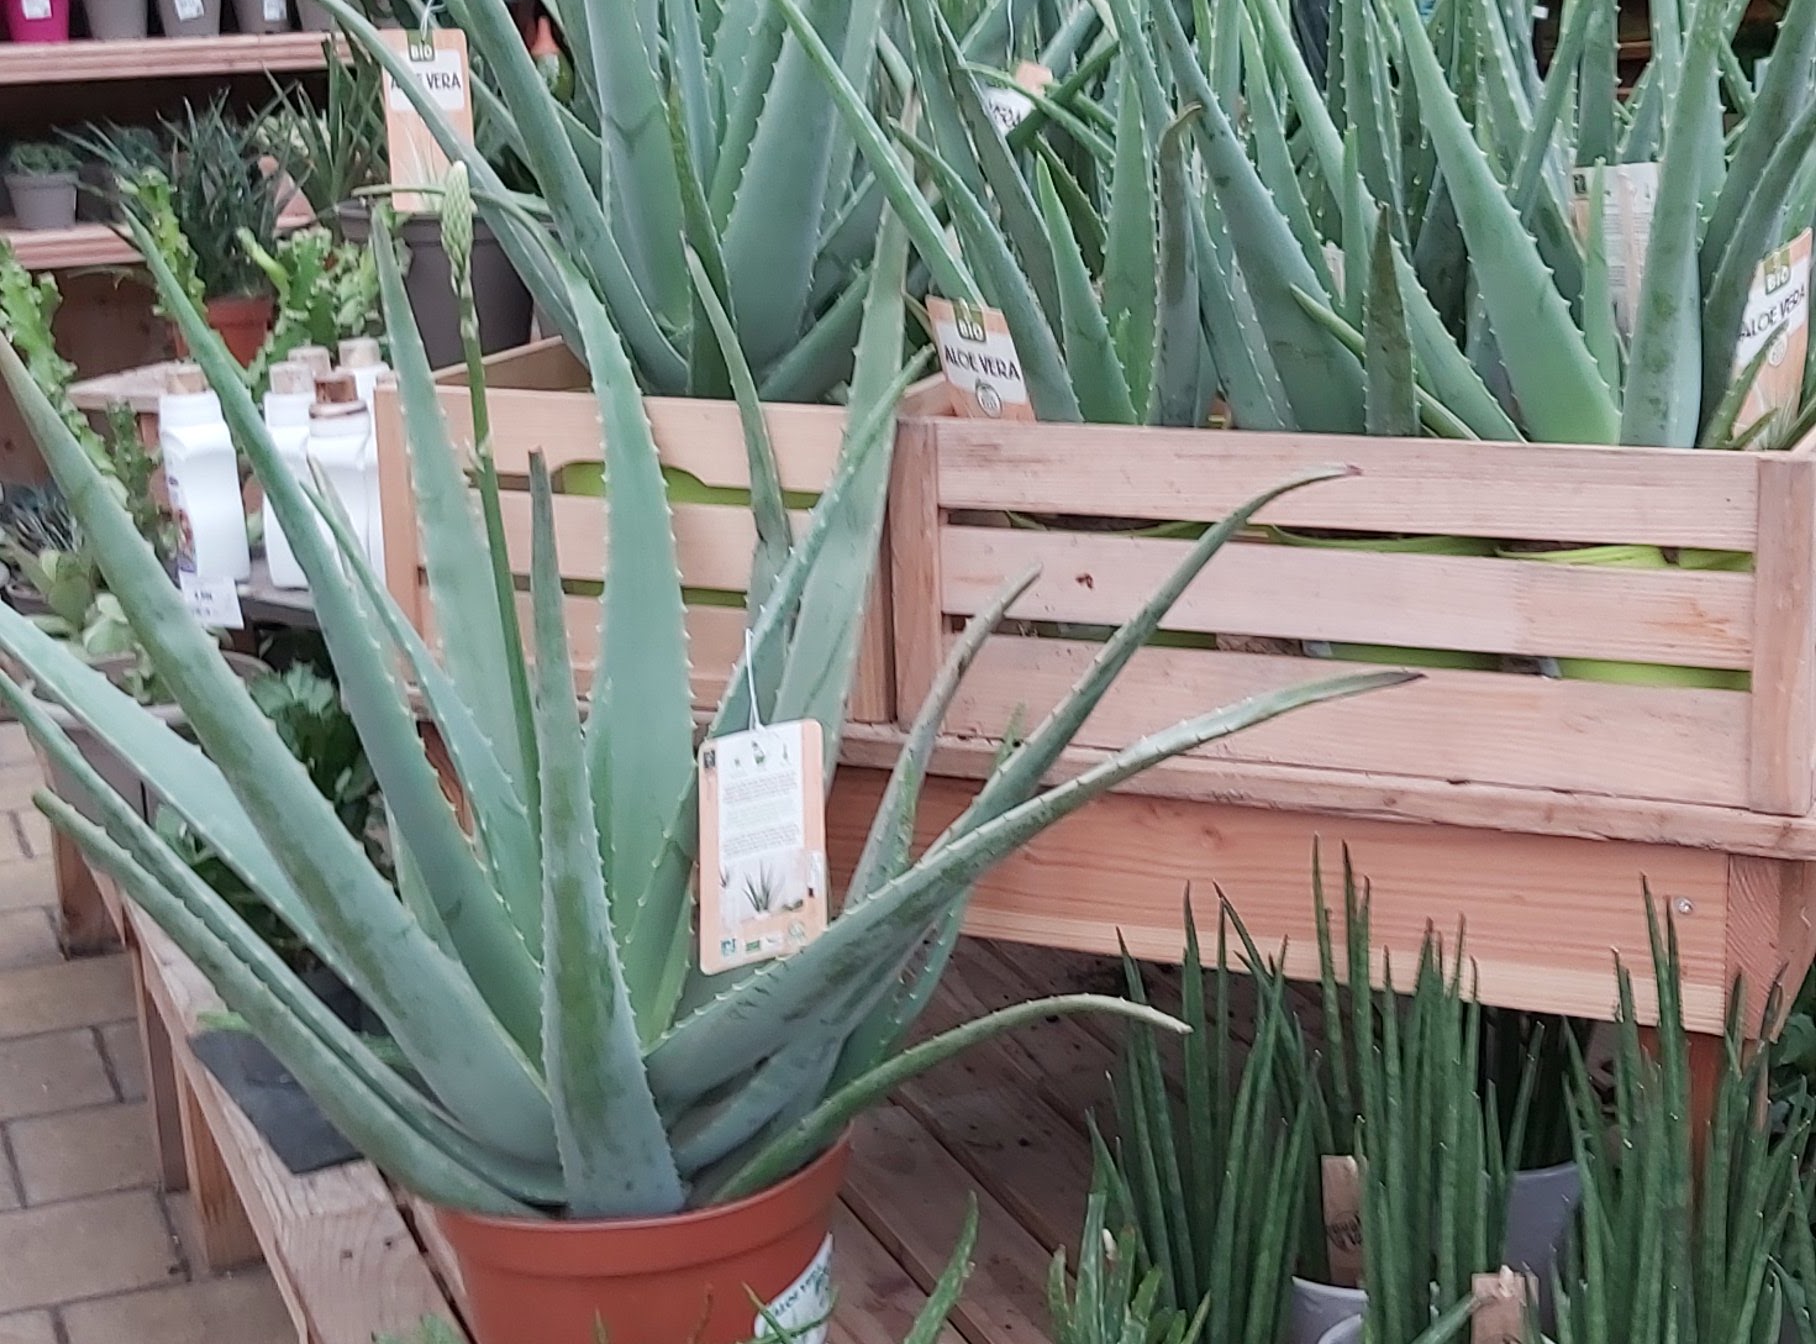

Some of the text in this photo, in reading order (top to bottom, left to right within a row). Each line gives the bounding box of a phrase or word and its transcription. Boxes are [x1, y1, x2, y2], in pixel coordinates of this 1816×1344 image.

[410, 43, 433, 60] BIO
[426, 72, 462, 89] VERA
[1766, 265, 1789, 292] BIO
[1739, 284, 1805, 343] ALOE VERA
[957, 319, 985, 342] BIO
[944, 345, 1021, 381] ALOE VERA
